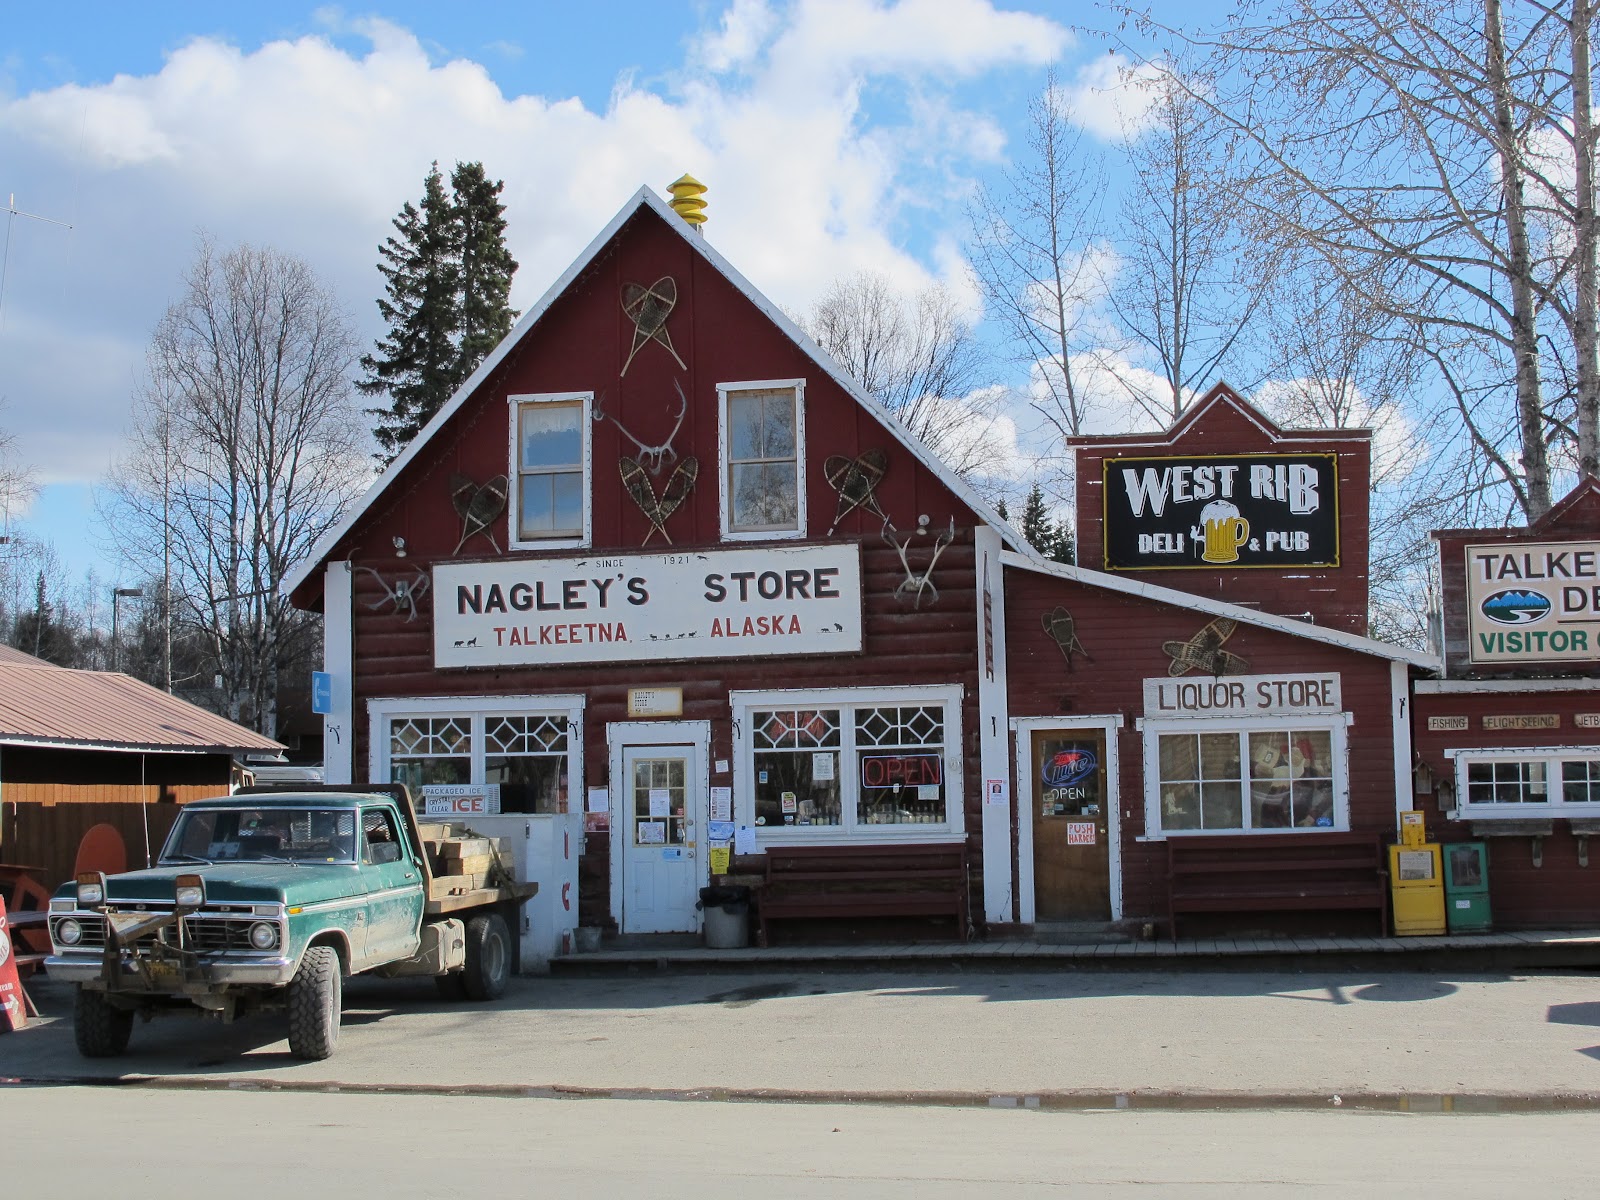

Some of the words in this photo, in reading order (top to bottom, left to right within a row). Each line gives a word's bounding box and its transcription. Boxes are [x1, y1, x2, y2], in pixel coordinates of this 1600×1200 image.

[1122, 465, 1239, 518] WEST
[1249, 464, 1319, 514] RIB
[1138, 533, 1184, 554] DELI
[1249, 538, 1260, 551] &
[1266, 531, 1310, 552] PUB
[596, 559, 624, 568] SINCE
[663, 556, 689, 565] 1921
[1477, 551, 1597, 580] TALKE
[457, 573, 650, 615] NAGLEY'S
[704, 567, 840, 602] STORE
[710, 614, 802, 638] ALASKA
[1479, 630, 1588, 653] VISITOR
[1158, 682, 1245, 711] LIQUOR
[1256, 680, 1335, 708] STORE
[1488, 715, 1554, 729] FLIGHTSEEING
[865, 758, 940, 785] OPEN
[452, 797, 483, 812] ICE
[1050, 787, 1085, 800] OPEN
[1069, 823, 1094, 834] PUSH
